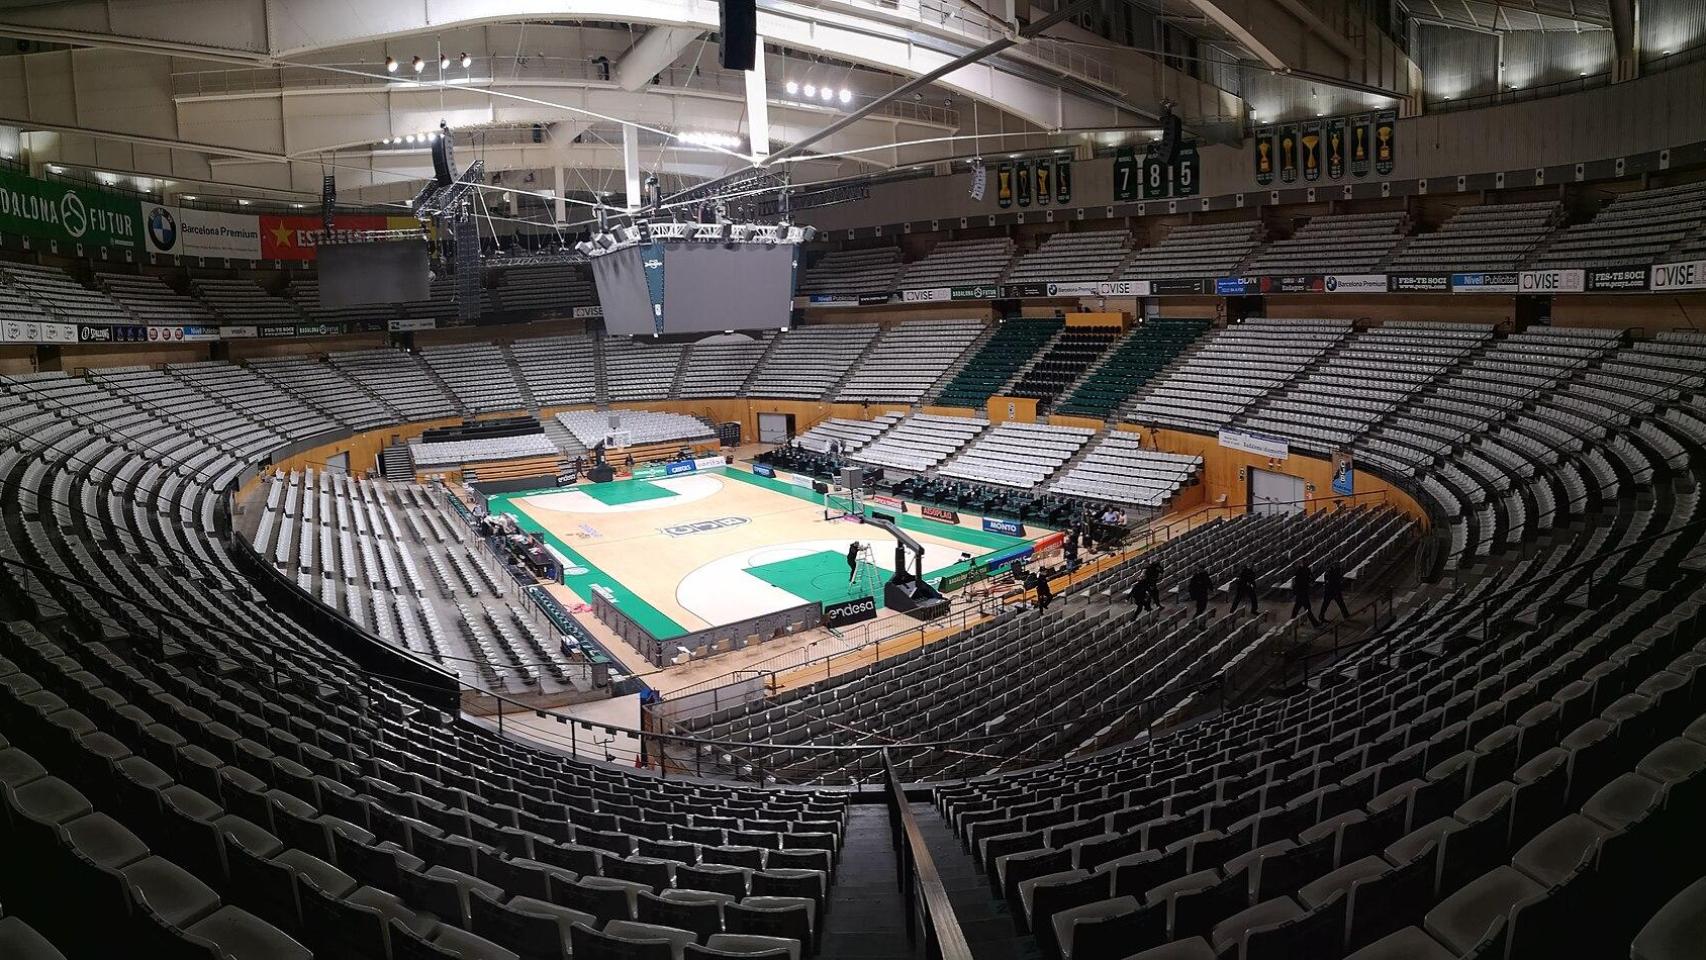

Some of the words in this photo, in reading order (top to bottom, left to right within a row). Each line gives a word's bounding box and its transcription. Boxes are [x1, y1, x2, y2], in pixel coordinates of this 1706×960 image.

[1120, 167, 1130, 191] 7
[1150, 163, 1160, 188] 8
[1180, 160, 1191, 185] 5
[90, 208, 133, 237] FUTUR
[181, 223, 219, 236] Barcelona
[220, 226, 258, 239] Premium
[990, 521, 1017, 533] MONTO
[828, 600, 874, 620] endesa
